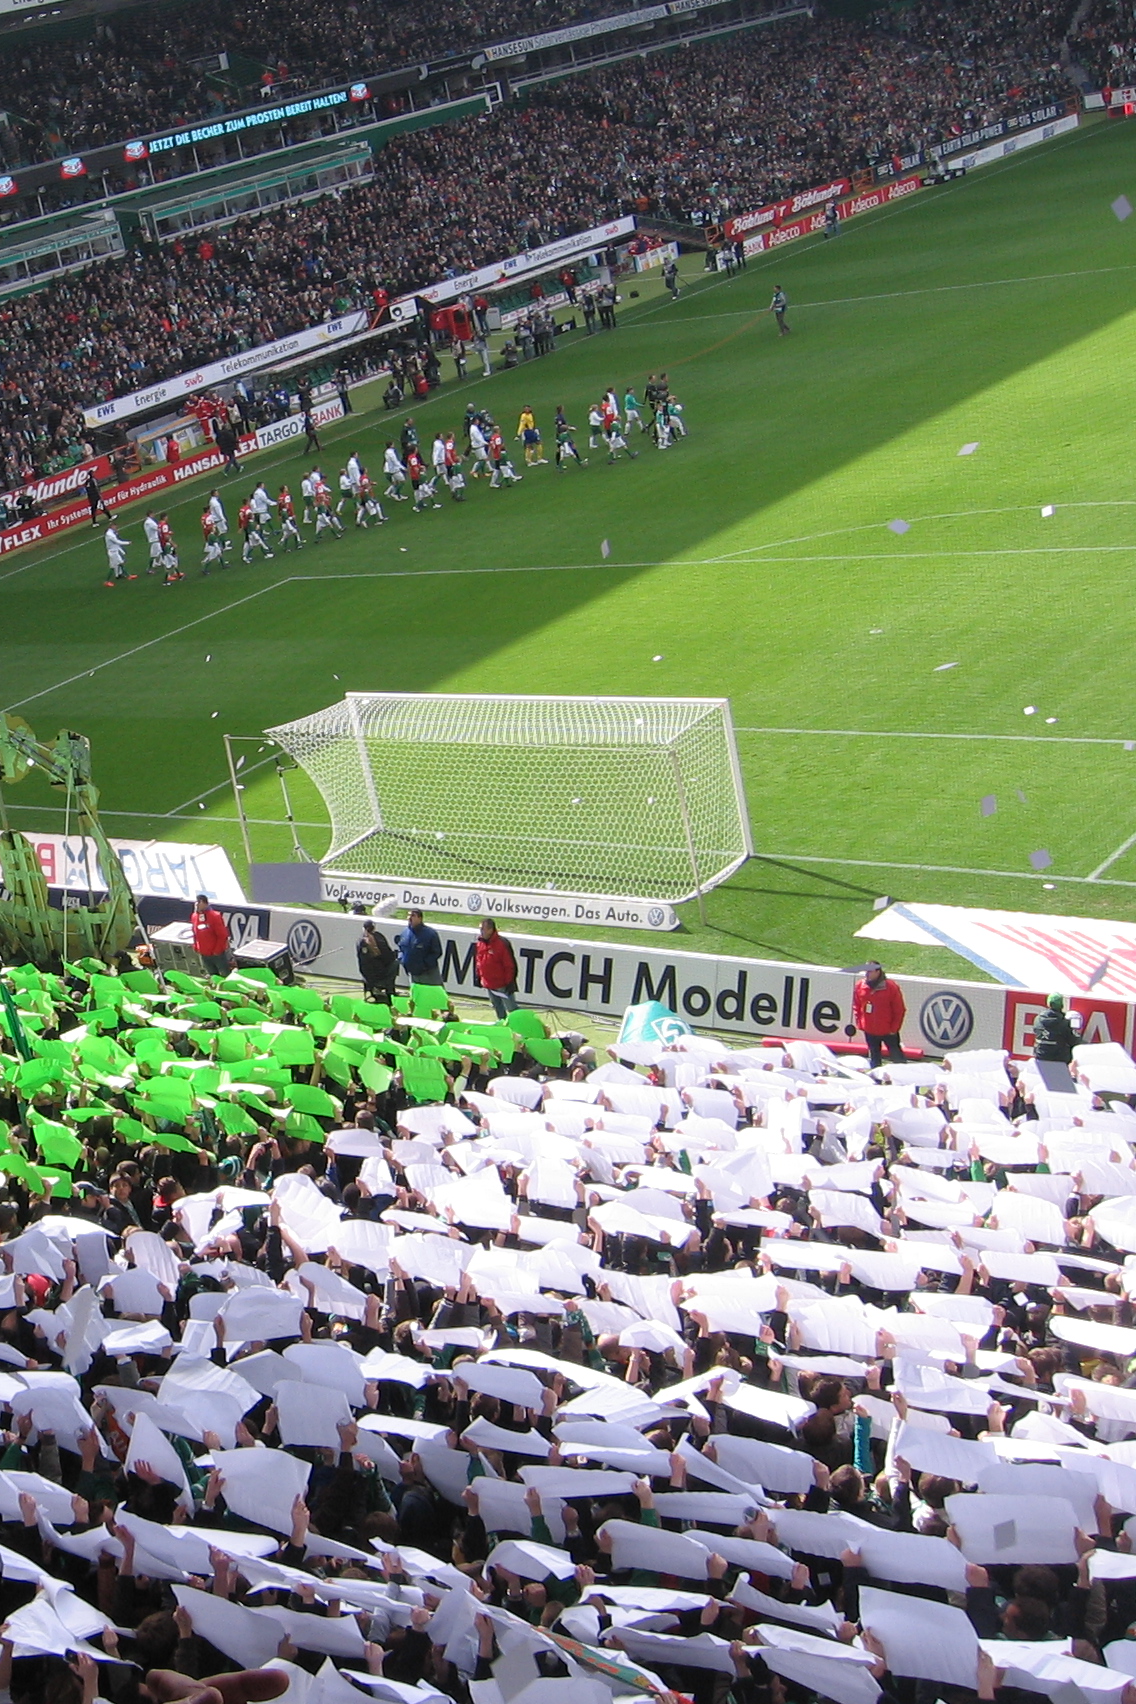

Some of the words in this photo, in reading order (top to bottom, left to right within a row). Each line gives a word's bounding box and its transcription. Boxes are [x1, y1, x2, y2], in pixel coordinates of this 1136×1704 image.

[149, 134, 174, 153] JETZT
[175, 131, 190, 146] DIE
[192, 123, 225, 142] BECHER
[226, 119, 245, 135] ZUM
[246, 106, 285, 128] PROSTEN
[285, 99, 312, 117] BEREIT
[888, 180, 916, 199] Adecco
[850, 193, 879, 214] Adecco
[810, 210, 840, 229] Adeo
[768, 225, 800, 247] Adecco
[503, 259, 518, 271] EWE
[97, 403, 116, 418] EWE
[134, 387, 167, 407] Energie
[184, 373, 204, 388] swb
[220, 340, 299, 374] Telekommunikation
[327, 320, 343, 334] EWE
[258, 422, 299, 447] TARGO
[46, 519, 59, 530] Ihr
[403, 890, 426, 905] Das
[429, 892, 463, 908] Auto.
[486, 897, 571, 919] Volkswagen.
[575, 904, 602, 921] Das
[605, 907, 643, 924] Auto.
[441, 940, 614, 1005] MTCH
[631, 961, 857, 1037] Modelle.
